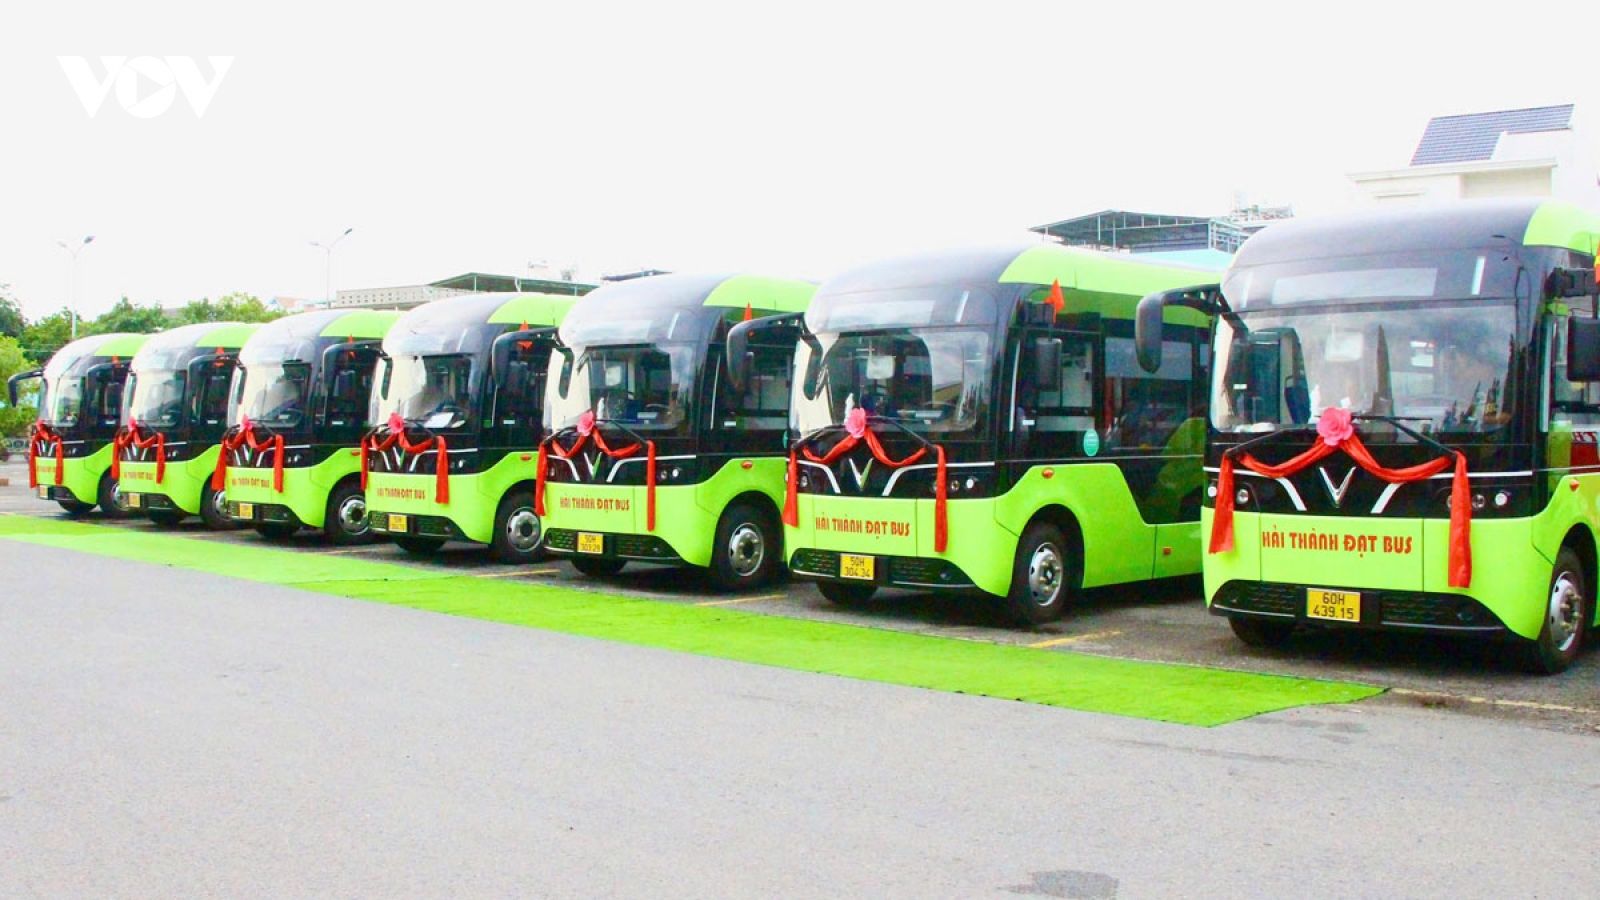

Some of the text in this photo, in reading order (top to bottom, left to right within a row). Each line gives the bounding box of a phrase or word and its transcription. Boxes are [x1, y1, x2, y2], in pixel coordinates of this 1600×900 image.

[615, 499, 630, 511] BUS
[815, 512, 910, 539] HẢI THÀNH ĐẠT BUS
[1262, 524, 1413, 558] HẢI THÀNH ĐẠT BUS
[844, 566, 870, 577] 30434
[1323, 592, 1344, 605] 60H
[1313, 604, 1354, 619] 439.15
